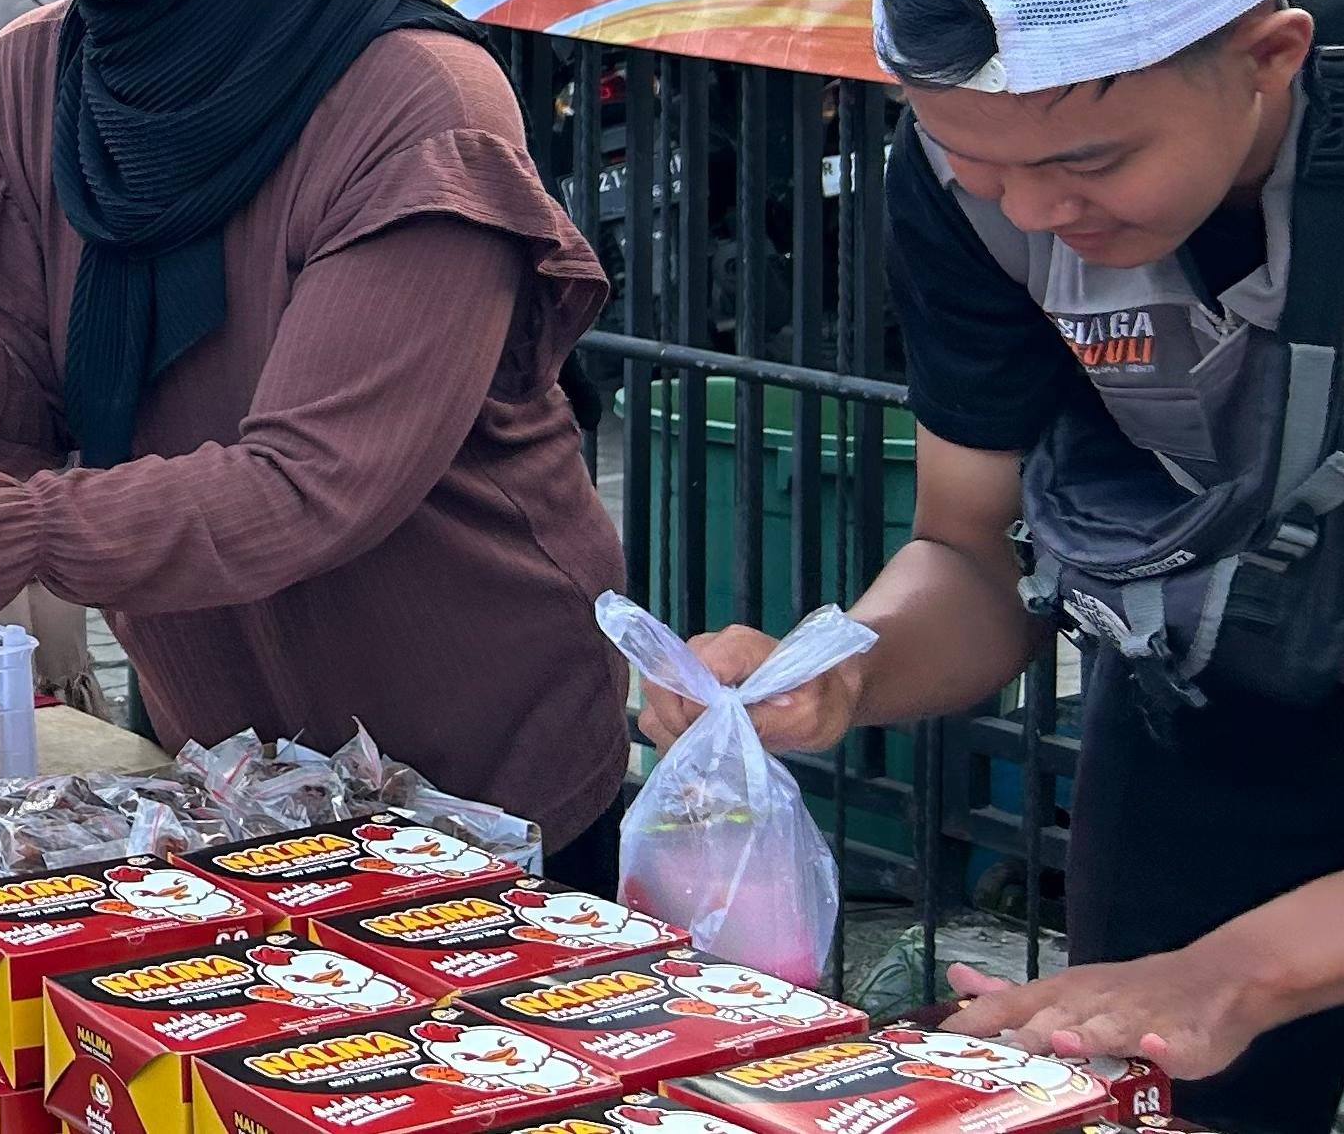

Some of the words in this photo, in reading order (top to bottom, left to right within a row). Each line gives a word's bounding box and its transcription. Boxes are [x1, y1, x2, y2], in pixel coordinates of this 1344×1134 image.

[1058, 312, 1154, 344] SIAGA
[218, 835, 353, 869] NALINA
[365, 900, 505, 934] NALINA
[98, 957, 247, 992] NALINA
[176, 973, 246, 989] Chicken
[508, 972, 658, 1013] NALINA
[76, 1026, 112, 1058] NALINA
[251, 1034, 411, 1074] NALINA
[288, 1064, 341, 1079] Fried
[335, 1050, 411, 1069] Chicken
[727, 1040, 879, 1083] NALINA
